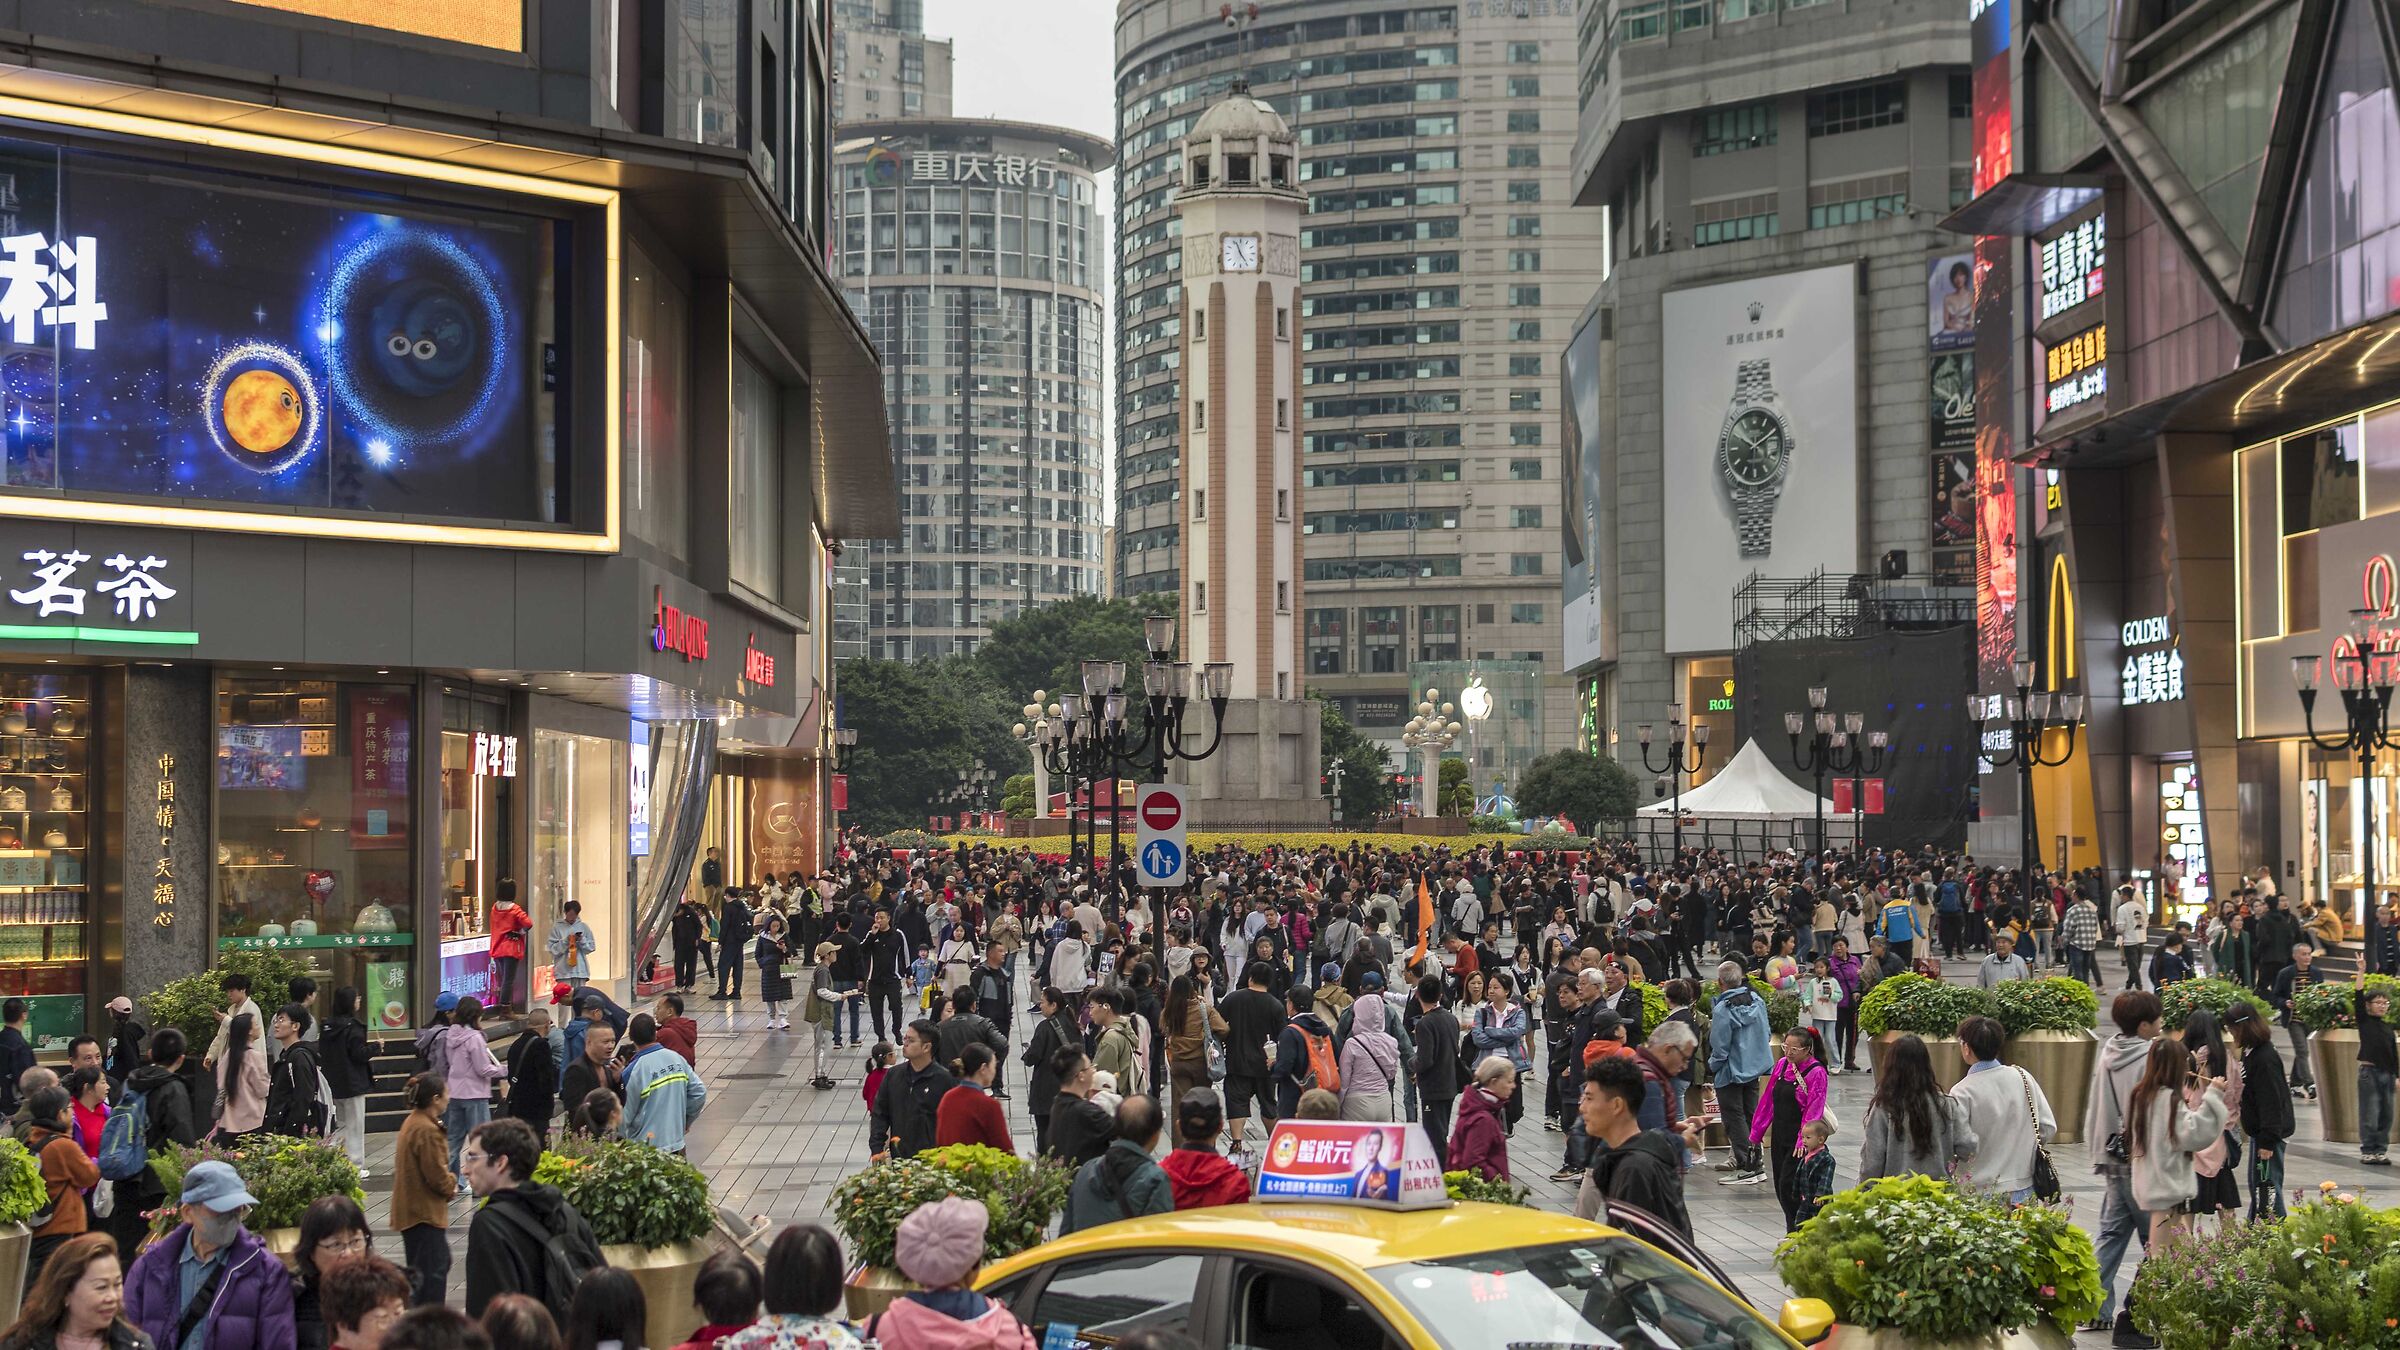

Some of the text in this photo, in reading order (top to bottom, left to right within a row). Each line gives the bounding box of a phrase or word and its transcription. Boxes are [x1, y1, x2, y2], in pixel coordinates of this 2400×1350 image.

[912, 151, 1058, 190] 重庆银行
[0, 232, 108, 349] 科
[10, 549, 177, 622] 茗茶
[2123, 616, 2168, 647] GOLDEN
[2122, 648, 2184, 705] 金鹰美食
[365, 712, 377, 781] 重庆特产茶
[474, 731, 518, 777] 放牛班
[761, 846, 804, 857] 中国金
[389, 967, 406, 989] 聘
[1296, 1139, 1353, 1164] 蟹状元
[1405, 1158, 1435, 1171] TAXI
[1403, 1175, 1441, 1192] 出租汽车
